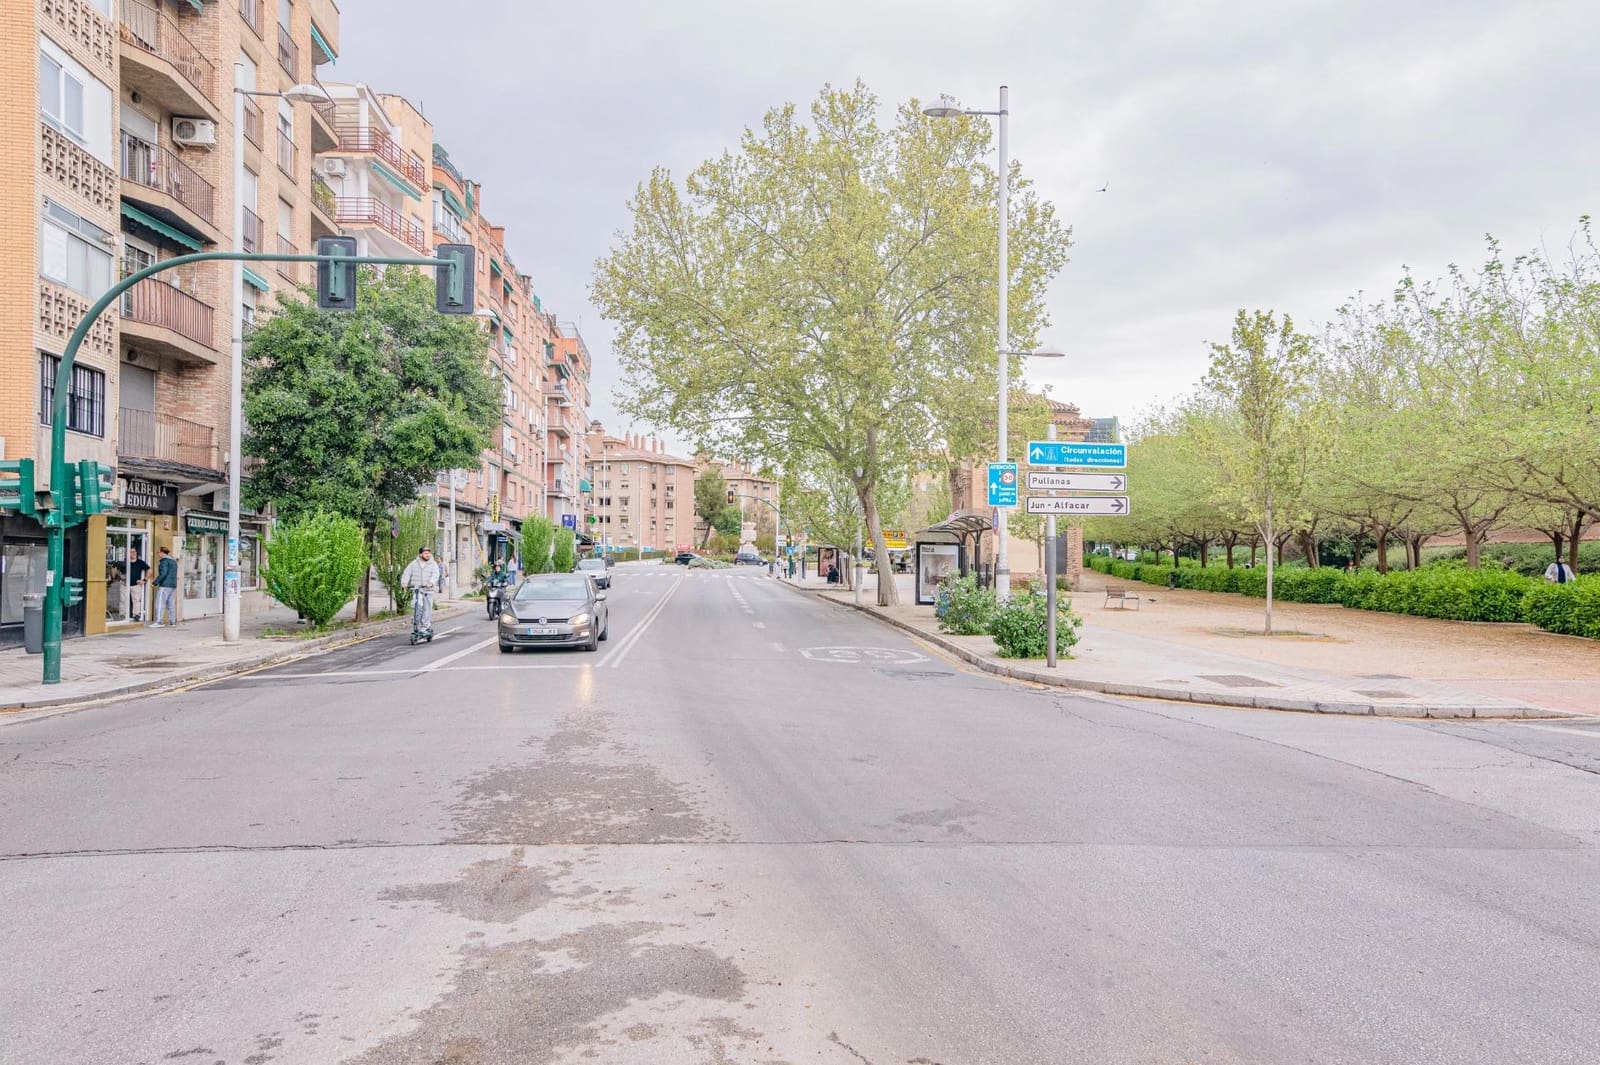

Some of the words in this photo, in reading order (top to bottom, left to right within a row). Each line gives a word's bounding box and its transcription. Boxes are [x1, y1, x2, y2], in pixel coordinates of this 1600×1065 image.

[1060, 446, 1123, 456] Circunvalación
[1032, 477, 1071, 486] Pulianas
[127, 494, 158, 509] EDUAR
[1054, 502, 1090, 510] Alfacar
